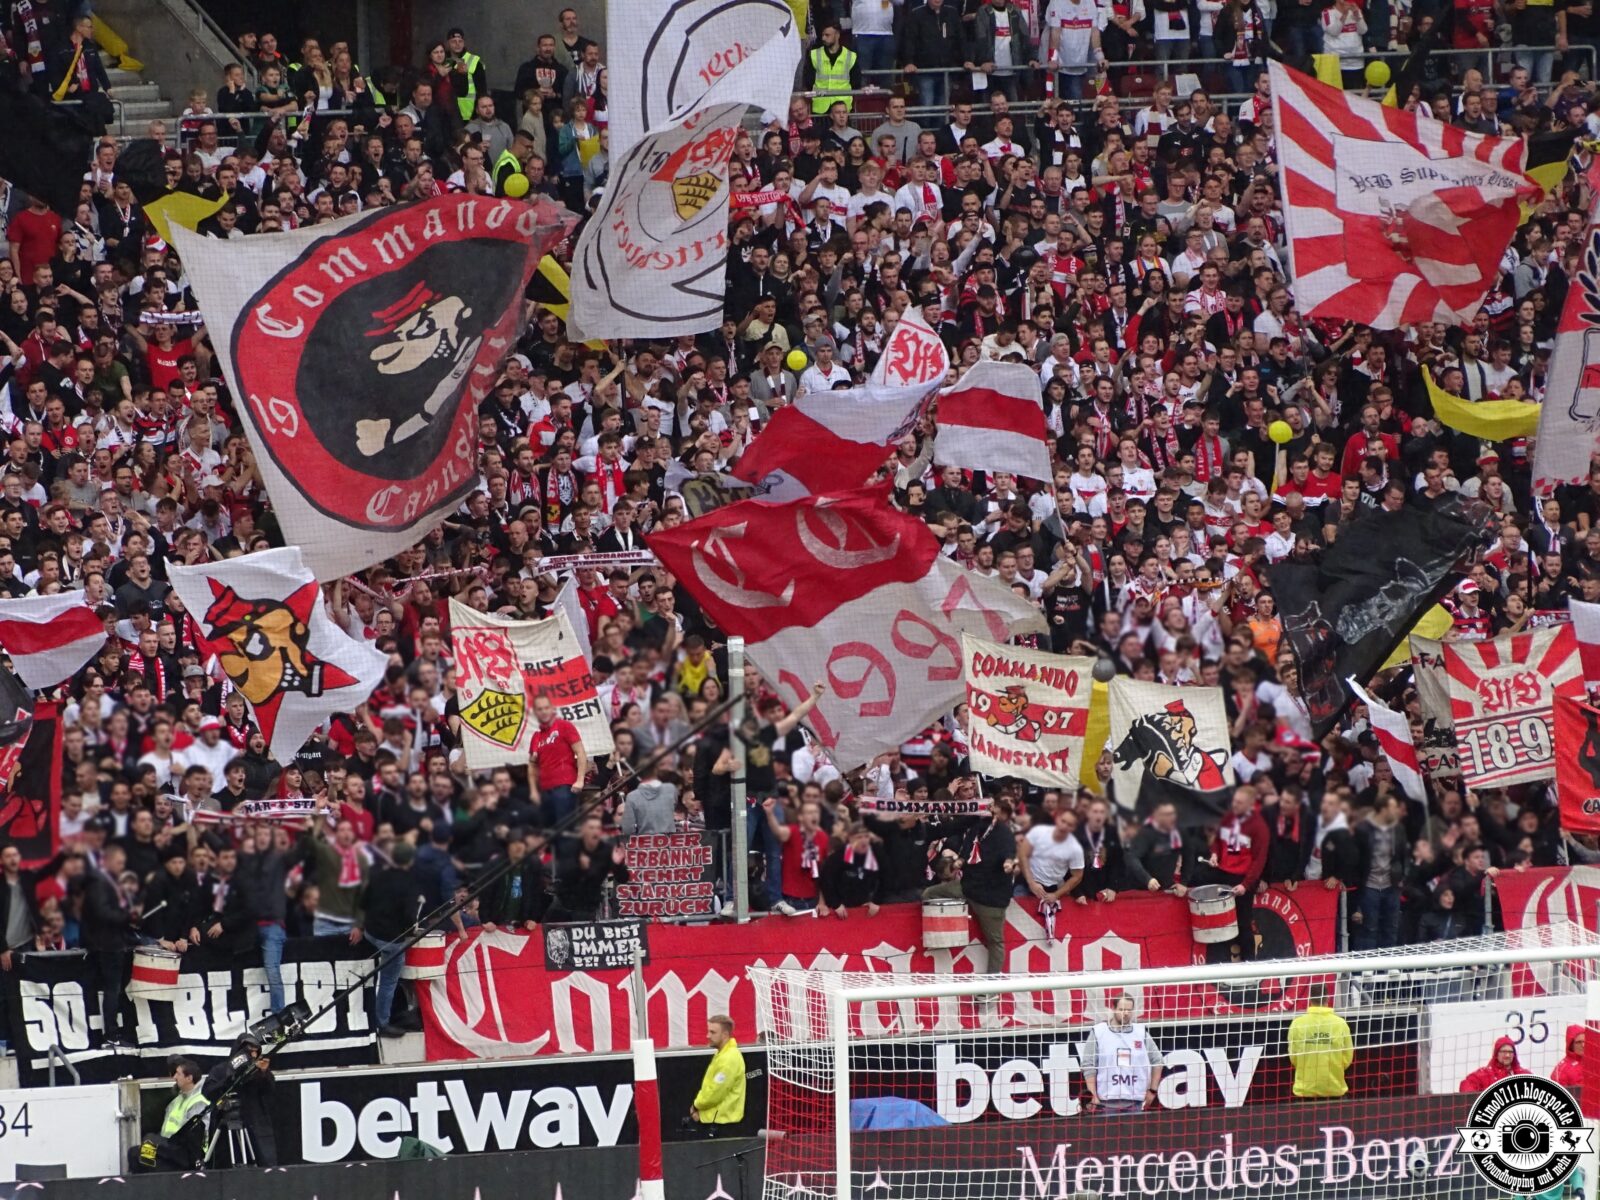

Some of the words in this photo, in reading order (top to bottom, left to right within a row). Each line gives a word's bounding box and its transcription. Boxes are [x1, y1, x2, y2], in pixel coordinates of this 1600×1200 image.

[255, 199, 541, 339] Commando
[250, 393, 300, 438] 19
[524, 656, 564, 677] BIST
[778, 573, 1011, 750] 1997
[972, 651, 1080, 698] COMMANDO
[559, 698, 601, 721] BEN
[970, 690, 992, 713] 19
[1042, 710, 1075, 729] 97
[970, 727, 1071, 774] CANNSTATT
[1464, 716, 1551, 776] 189
[876, 800, 980, 814] COMMANDO
[624, 846, 713, 869] ERBANNTE
[625, 833, 702, 849] JEDER
[627, 866, 705, 883] KEHRT
[571, 926, 597, 940] DU
[602, 924, 640, 939] BIST
[573, 938, 643, 956] IMMER
[420, 893, 1142, 1060] Commando
[573, 955, 600, 967] BEI
[605, 953, 635, 967] UNS
[172, 958, 375, 1041] BLEIBT
[1505, 1009, 1550, 1045] 35
[935, 1044, 1264, 1124] betay
[1111, 1074, 1139, 1087] SMF
[300, 1079, 635, 1164] betway
[1015, 1126, 1463, 1200] Mercedes-Benz
